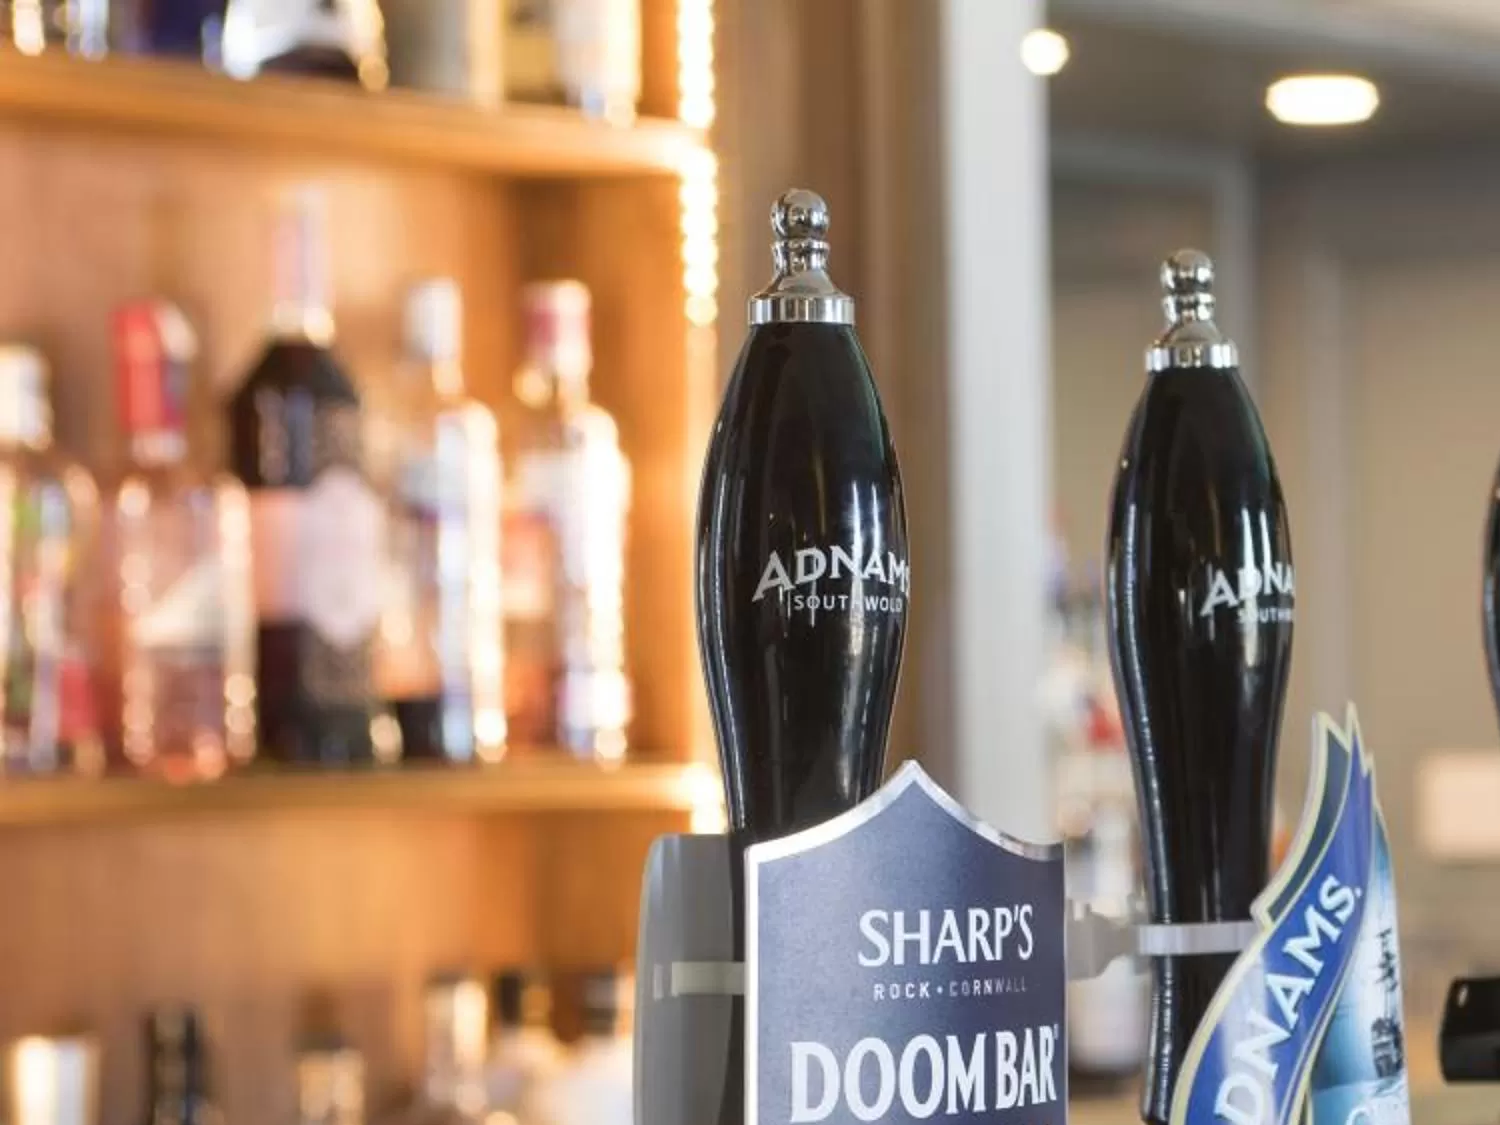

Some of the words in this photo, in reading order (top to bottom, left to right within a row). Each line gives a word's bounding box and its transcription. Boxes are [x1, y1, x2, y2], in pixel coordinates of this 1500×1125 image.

[857, 903, 1034, 968] SHARP'S
[873, 981, 931, 1000] ROCK
[949, 976, 1028, 997] CORNWALL
[790, 1033, 988, 1123] DOOM
